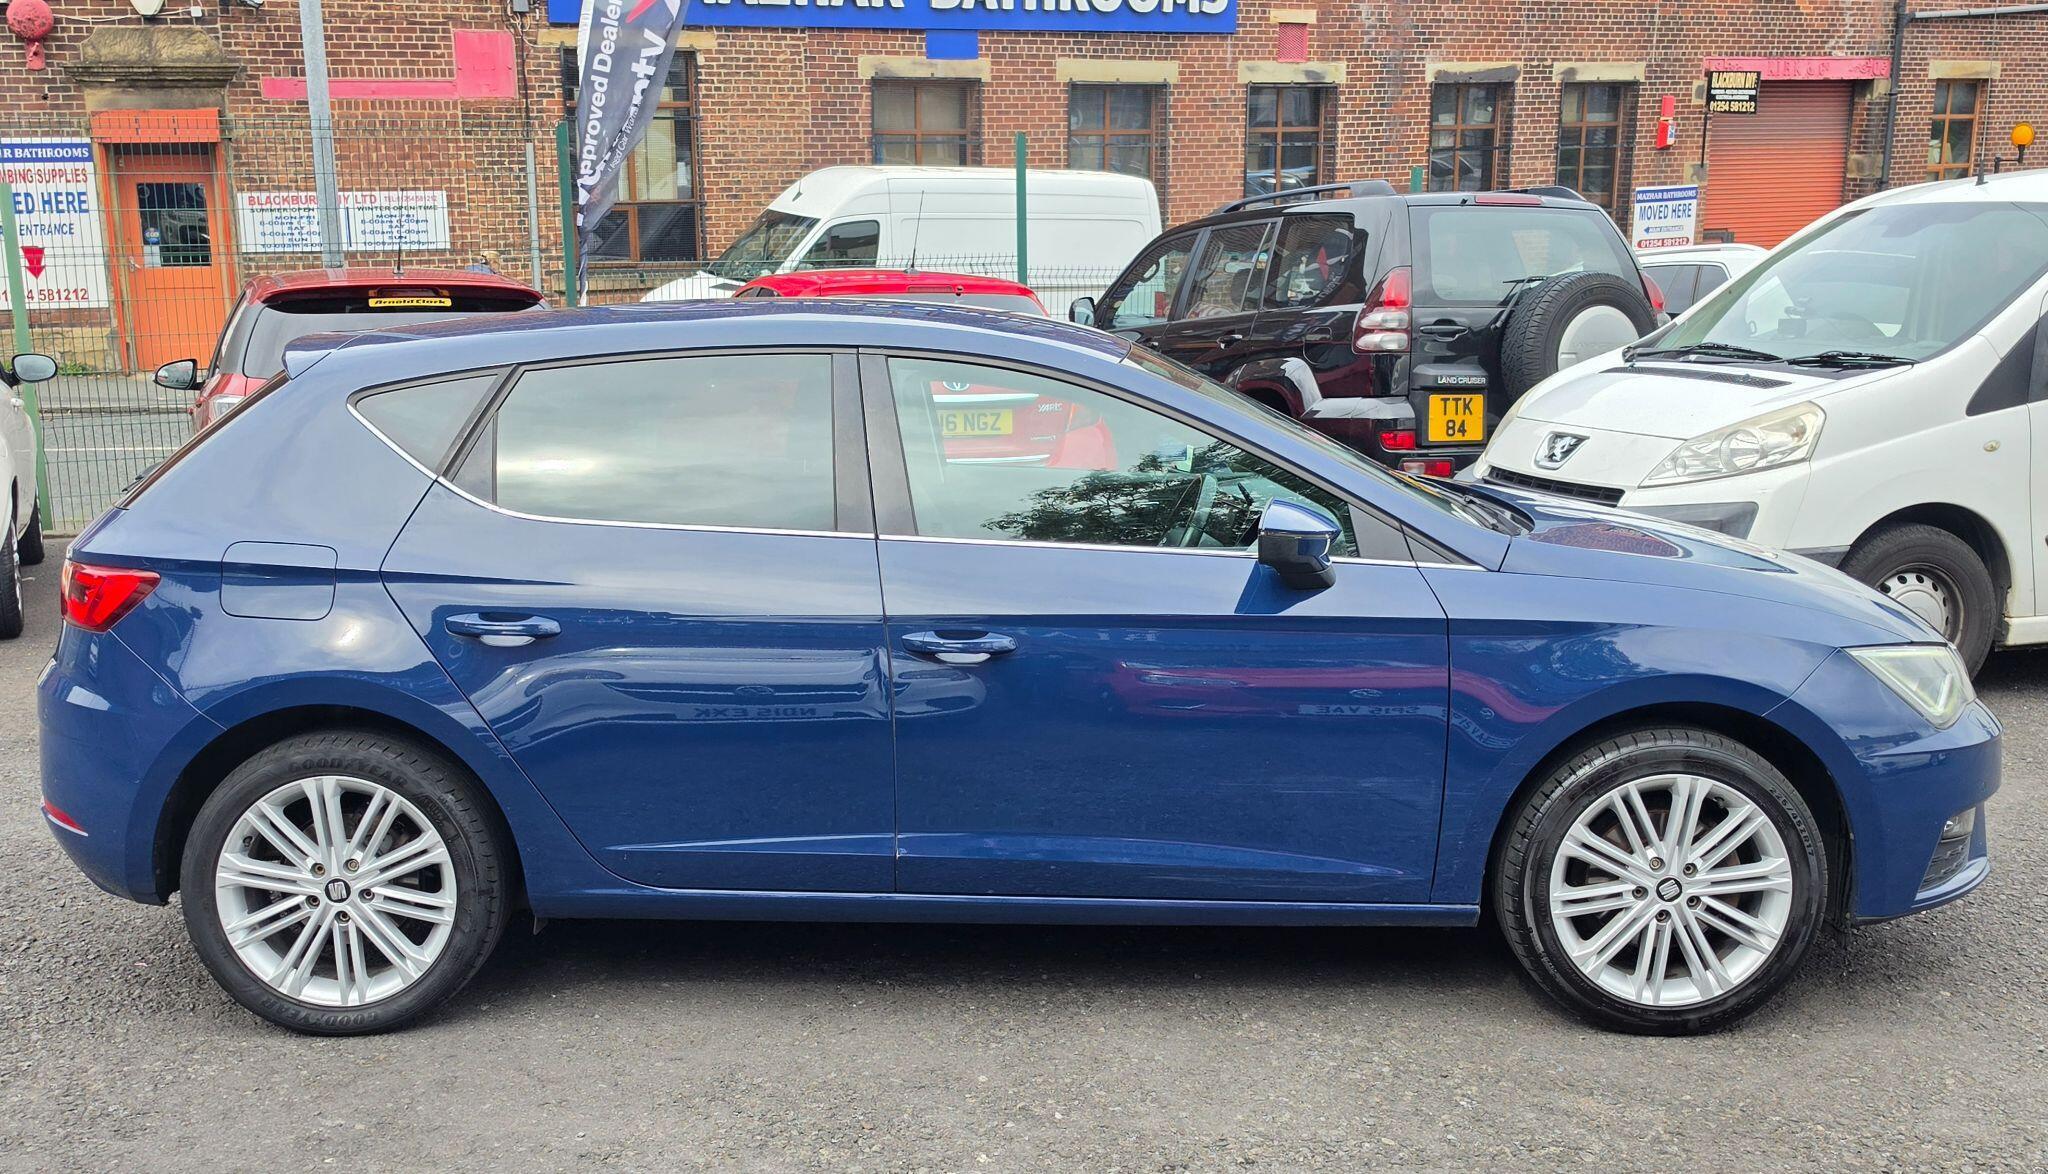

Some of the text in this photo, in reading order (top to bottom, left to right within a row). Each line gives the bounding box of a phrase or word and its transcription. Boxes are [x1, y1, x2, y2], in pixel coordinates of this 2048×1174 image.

[1710, 101, 1755, 112] 01254 581212
[580, 74, 608, 175] pproved
[617, 134, 629, 150] Car
[15, 147, 89, 158] BATHROOMS
[36, 168, 88, 184] SUPPLIES
[248, 195, 318, 206] BLACKBUR
[355, 194, 377, 204] LTD
[1637, 190, 1696, 200] MAZHAR BATHROOMS
[12, 191, 89, 214] ED HERE
[1639, 203, 1692, 220] MOVED HERE
[19, 223, 74, 236] ENTRANCE
[1641, 239, 1662, 247] 01254
[39, 288, 89, 301] 581212
[1438, 376, 1457, 384] LAND
[1440, 398, 1473, 416] TTK
[963, 412, 1002, 431] NGZ
[1446, 419, 1467, 437] 84
